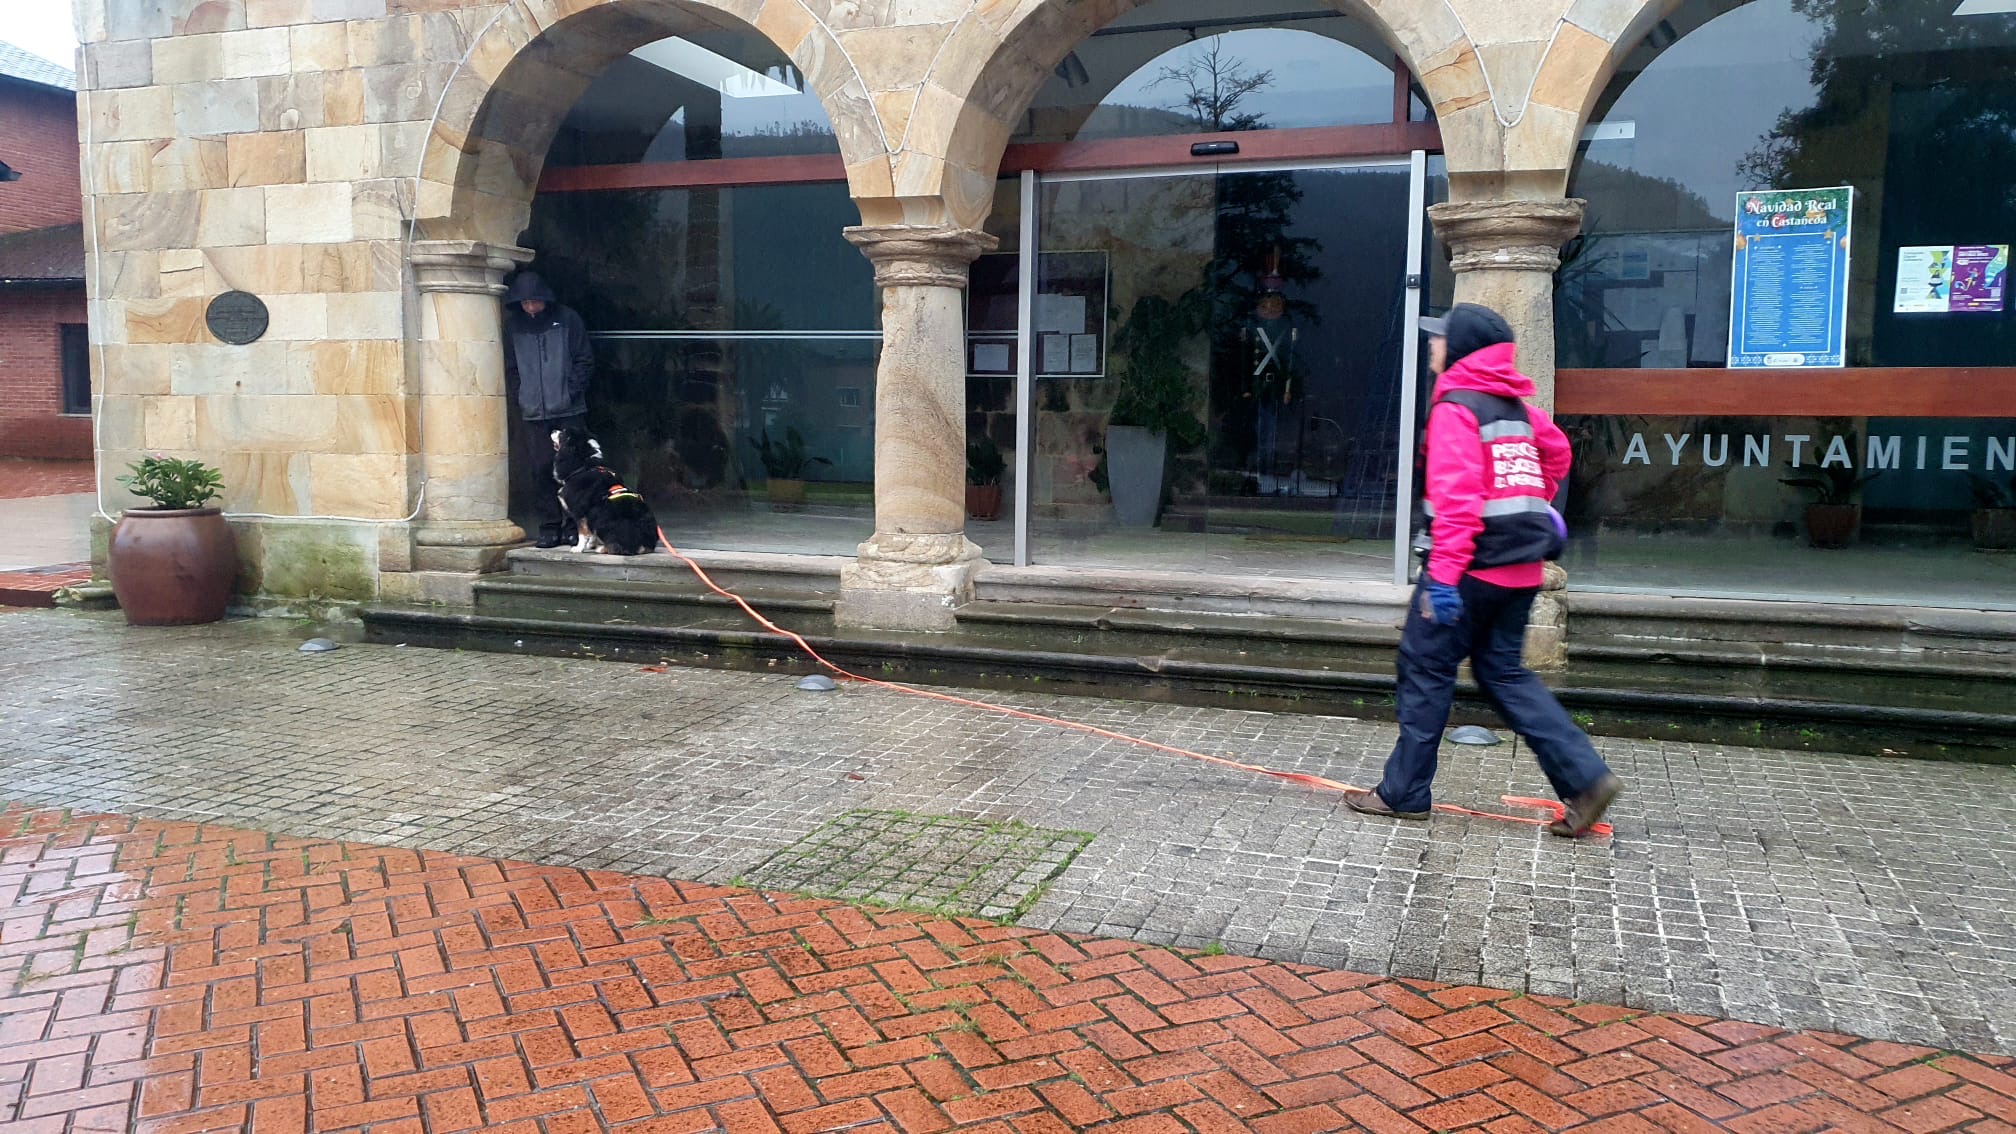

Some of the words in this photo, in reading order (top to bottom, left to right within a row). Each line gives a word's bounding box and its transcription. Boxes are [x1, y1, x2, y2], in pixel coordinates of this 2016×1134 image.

[1746, 199, 1802, 215] Navidad
[1805, 199, 1837, 213] Real
[1756, 216, 1770, 227] en
[1621, 432, 2016, 471] AYUNTAMIEN
